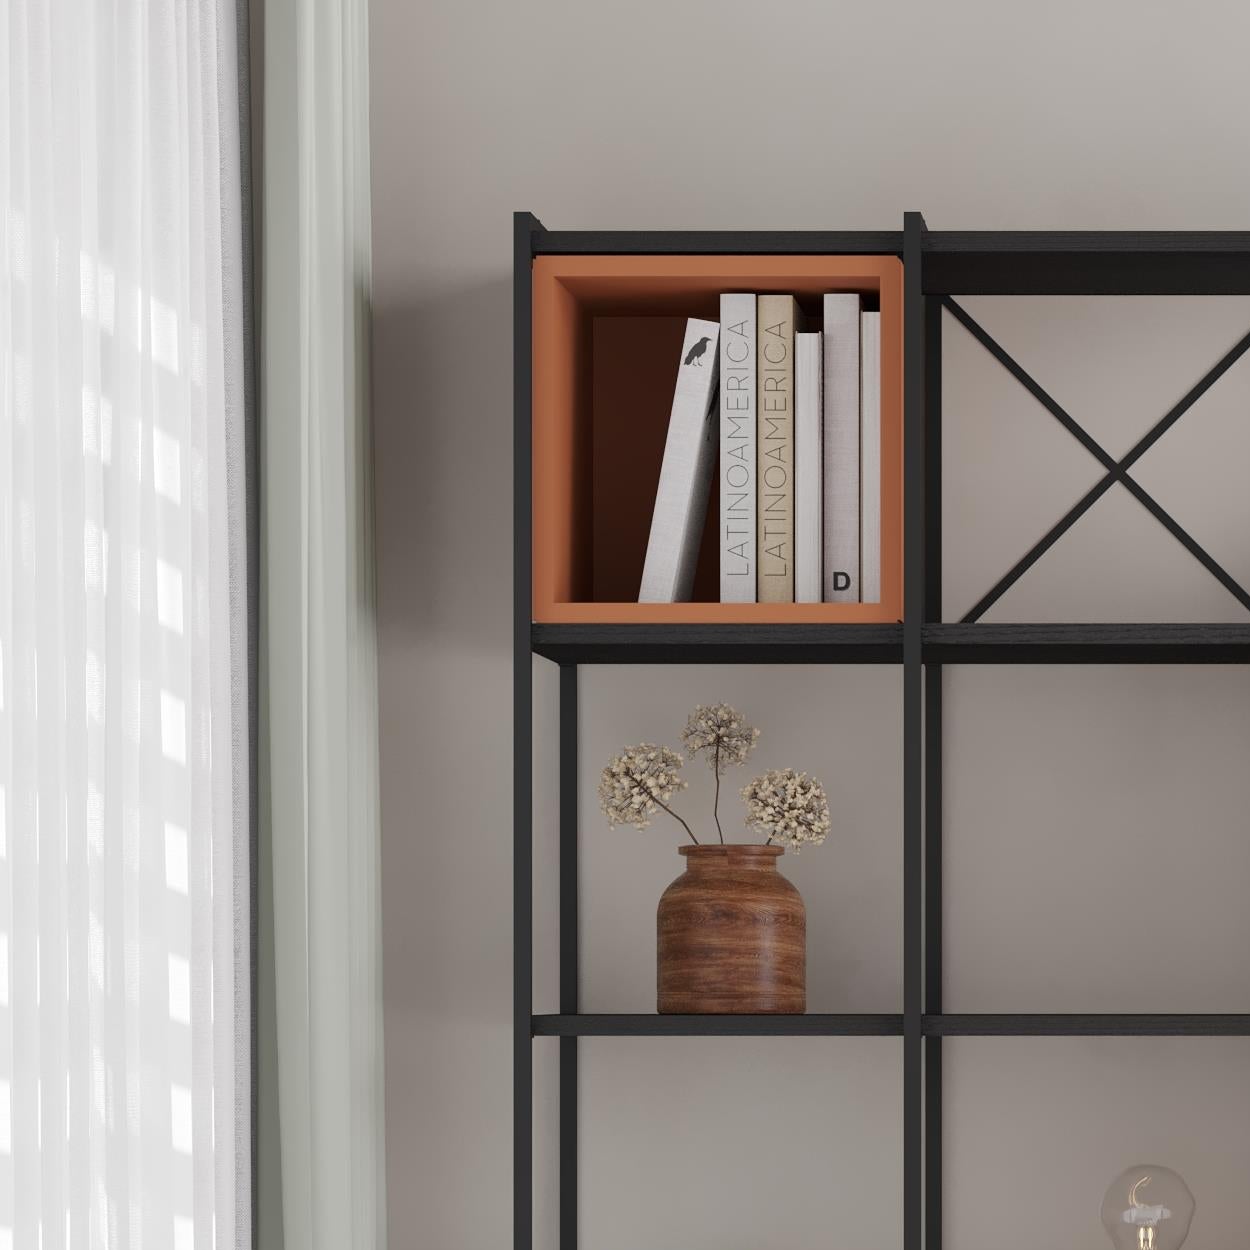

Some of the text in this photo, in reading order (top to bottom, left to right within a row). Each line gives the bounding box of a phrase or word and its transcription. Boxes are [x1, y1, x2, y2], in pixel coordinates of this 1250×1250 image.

[727, 319, 750, 577] LATINOAMERICA
[764, 320, 787, 577] LATINOAMERICA
[833, 572, 851, 591] D
